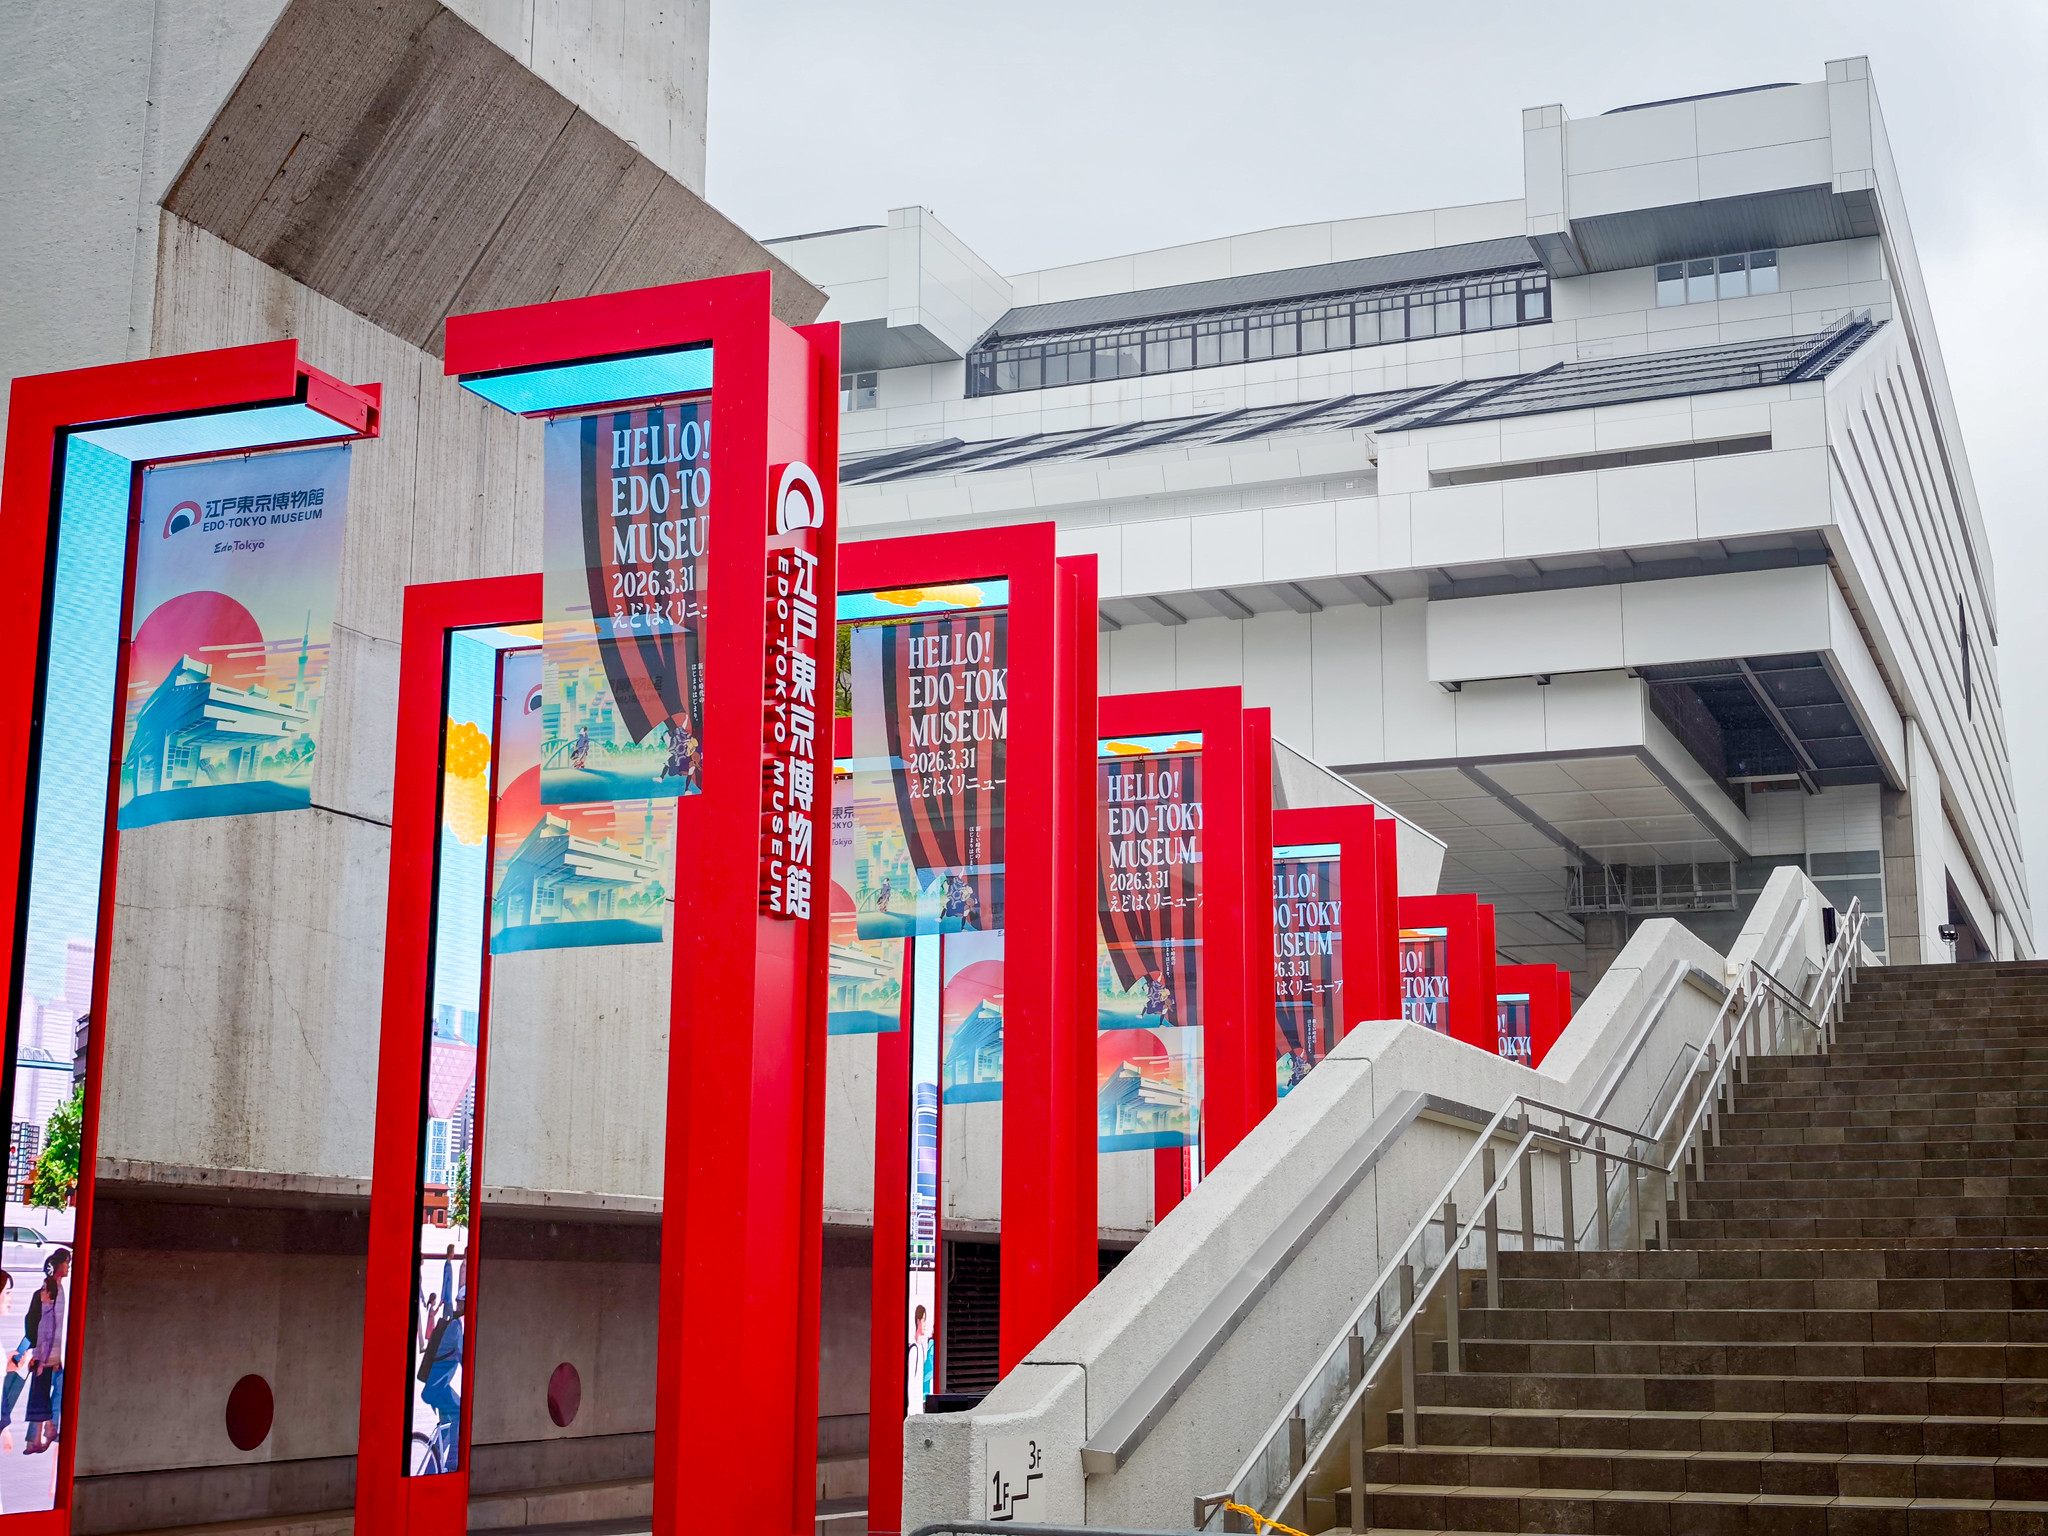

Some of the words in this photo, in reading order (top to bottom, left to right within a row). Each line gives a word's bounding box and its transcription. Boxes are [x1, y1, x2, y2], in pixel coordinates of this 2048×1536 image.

[611, 420, 710, 469] HELLO!
[205, 488, 324, 519] 江戸東京博物館
[611, 467, 711, 517] EDO-TO
[203, 515, 267, 533] EDO-TOKYO
[270, 509, 323, 525] MUSEUM
[612, 515, 710, 565] MUSEU
[612, 565, 694, 598] 2026.3.31
[774, 555, 789, 743] EDO-TOKYO
[908, 631, 991, 670] HELLO!
[908, 668, 1008, 709] EDO-TOK
[786, 546, 818, 920] 江戸東京博物館
[909, 707, 1008, 747] MUSEUM
[909, 747, 976, 774] 2026.3.31
[1107, 771, 1180, 803] HELLO!
[770, 760, 785, 912] MUSEUM
[1109, 836, 1197, 869] MUSEUM
[1109, 870, 1169, 891] 2026.3.31
[1028, 1440, 1042, 1470] 3F
[992, 1470, 1010, 1512] 1F
